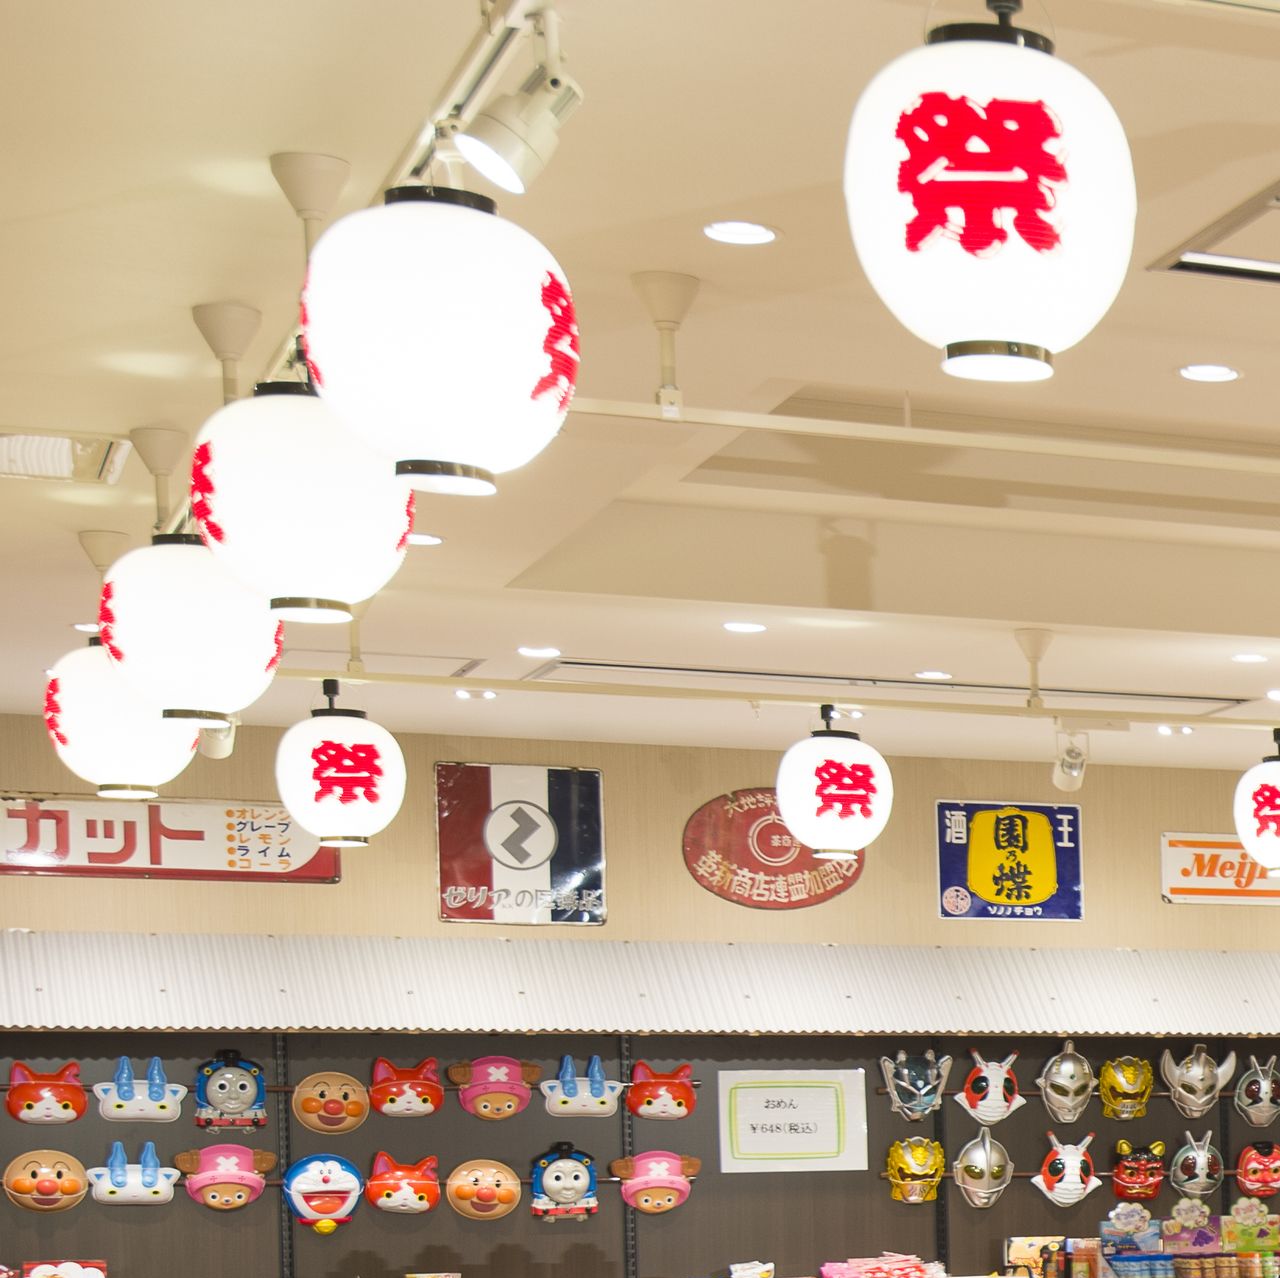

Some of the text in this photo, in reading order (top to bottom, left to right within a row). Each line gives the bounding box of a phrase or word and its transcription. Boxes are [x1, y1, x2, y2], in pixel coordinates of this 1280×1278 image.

[896, 92, 1066, 256] 祭
[312, 740, 383, 804] 祭
[815, 760, 877, 818] 祭
[236, 821, 291, 833] グレープ
[944, 810, 967, 844] 酒
[1056, 814, 1075, 847] 王
[237, 833, 292, 846] レモン
[237, 846, 292, 858] ライム
[237, 858, 292, 870] コーラ
[764, 1098, 799, 1111] おめん
